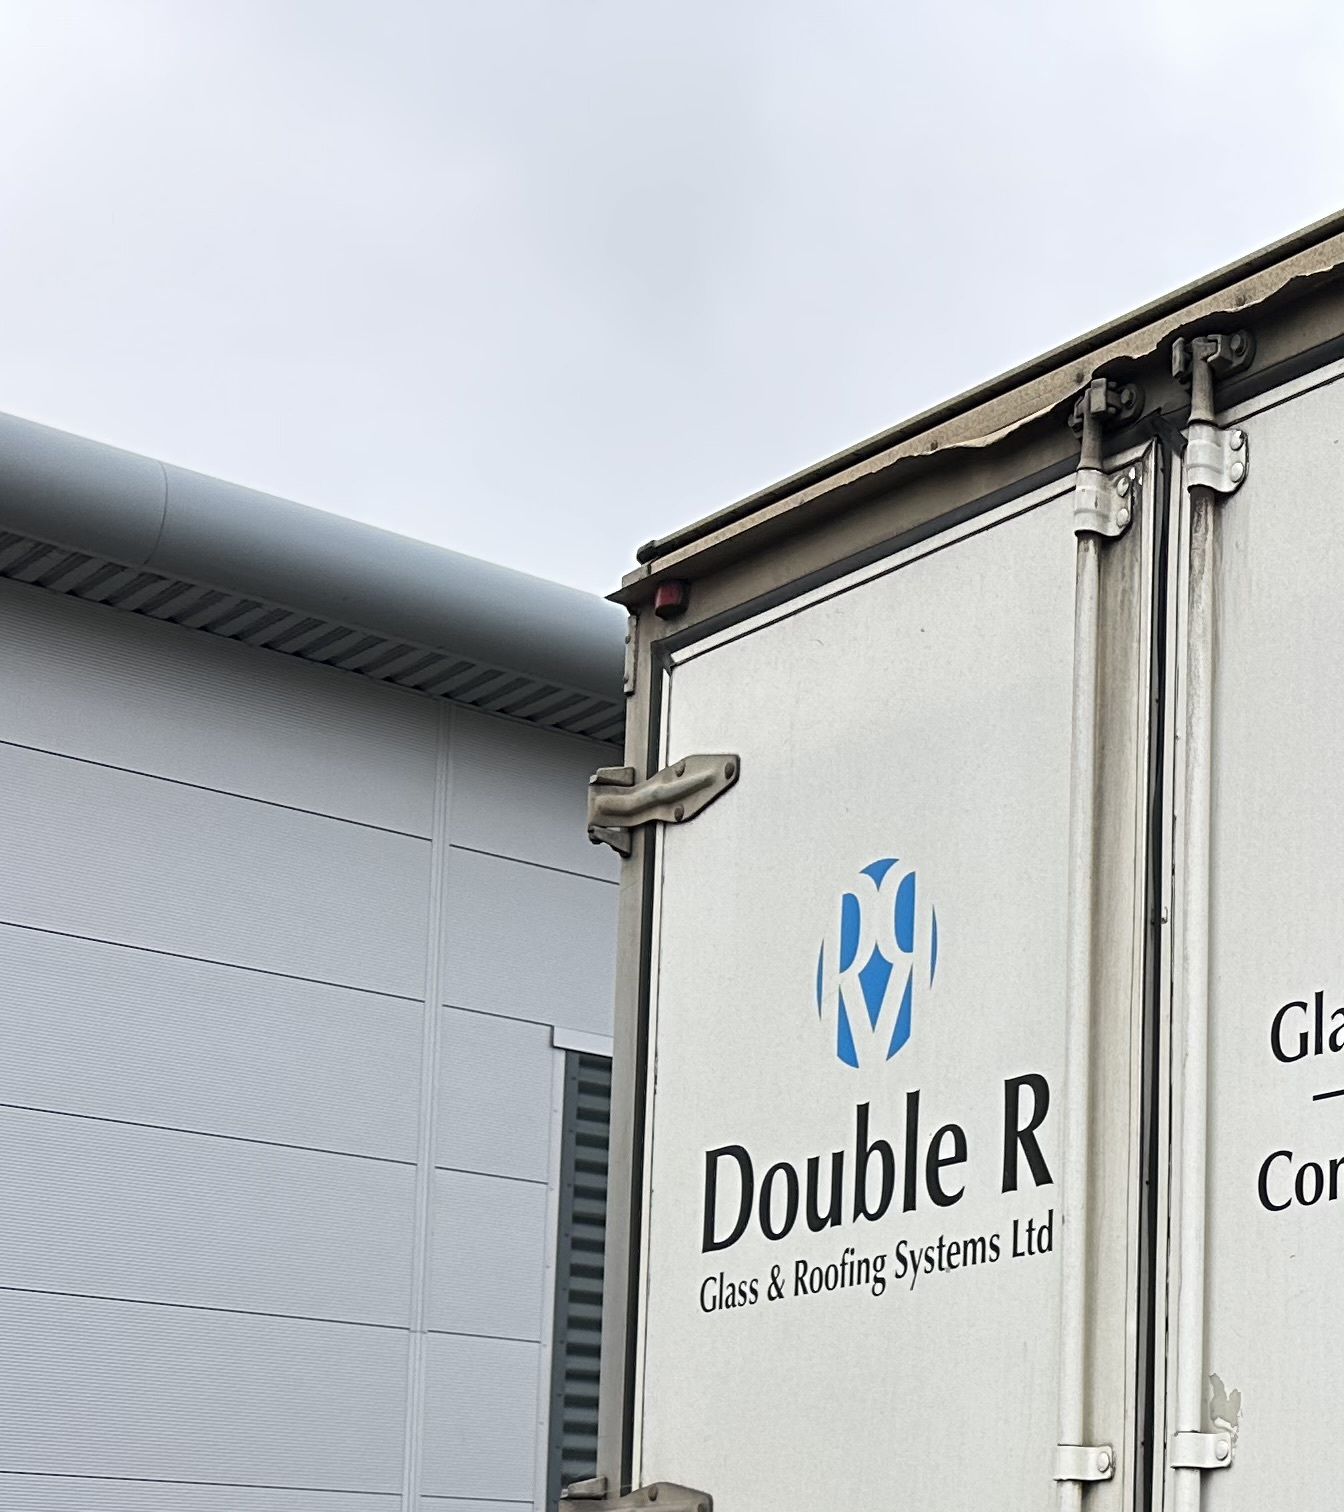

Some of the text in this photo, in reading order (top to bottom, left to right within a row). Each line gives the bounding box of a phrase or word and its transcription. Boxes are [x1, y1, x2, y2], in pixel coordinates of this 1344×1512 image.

[702, 1073, 1054, 1254] Double R
[700, 1209, 1054, 1313] Glass & Roofing Systems Ltd
